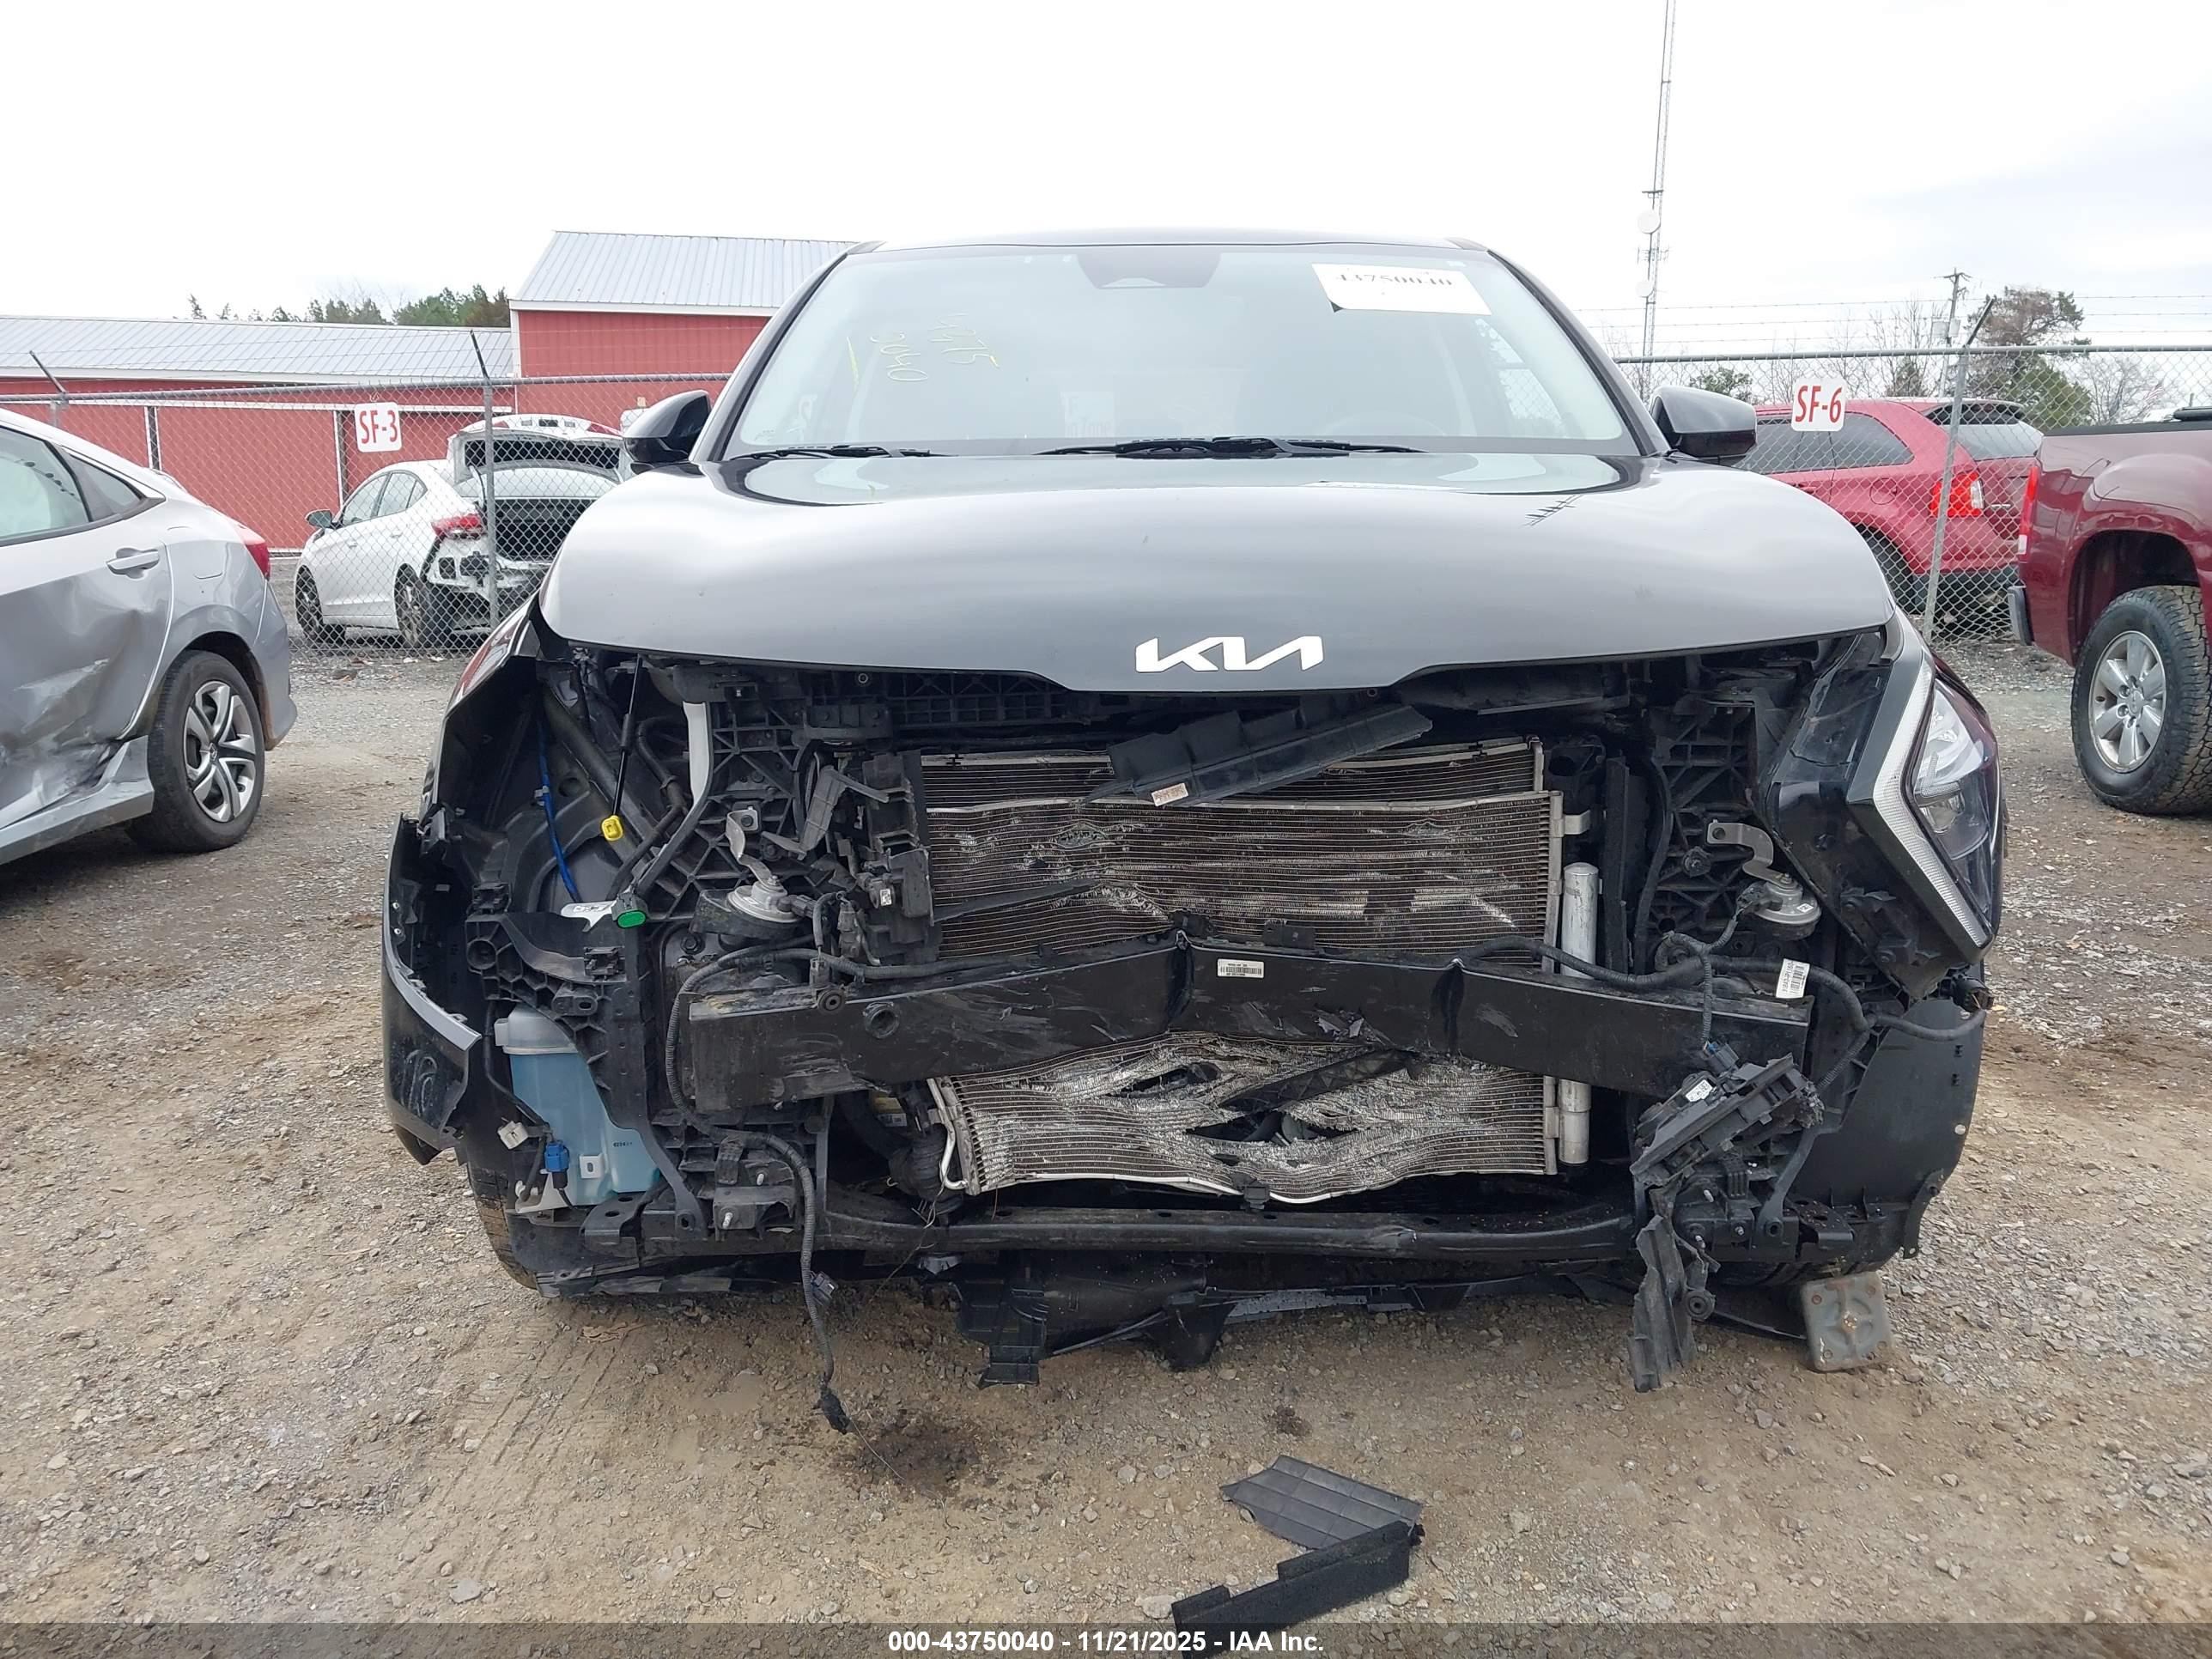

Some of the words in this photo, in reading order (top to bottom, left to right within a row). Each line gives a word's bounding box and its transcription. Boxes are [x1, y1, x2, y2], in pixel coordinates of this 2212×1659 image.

[1795, 385, 1843, 423] SF-6
[359, 410, 398, 444] SF-3
[1134, 635, 1325, 673] KIA
